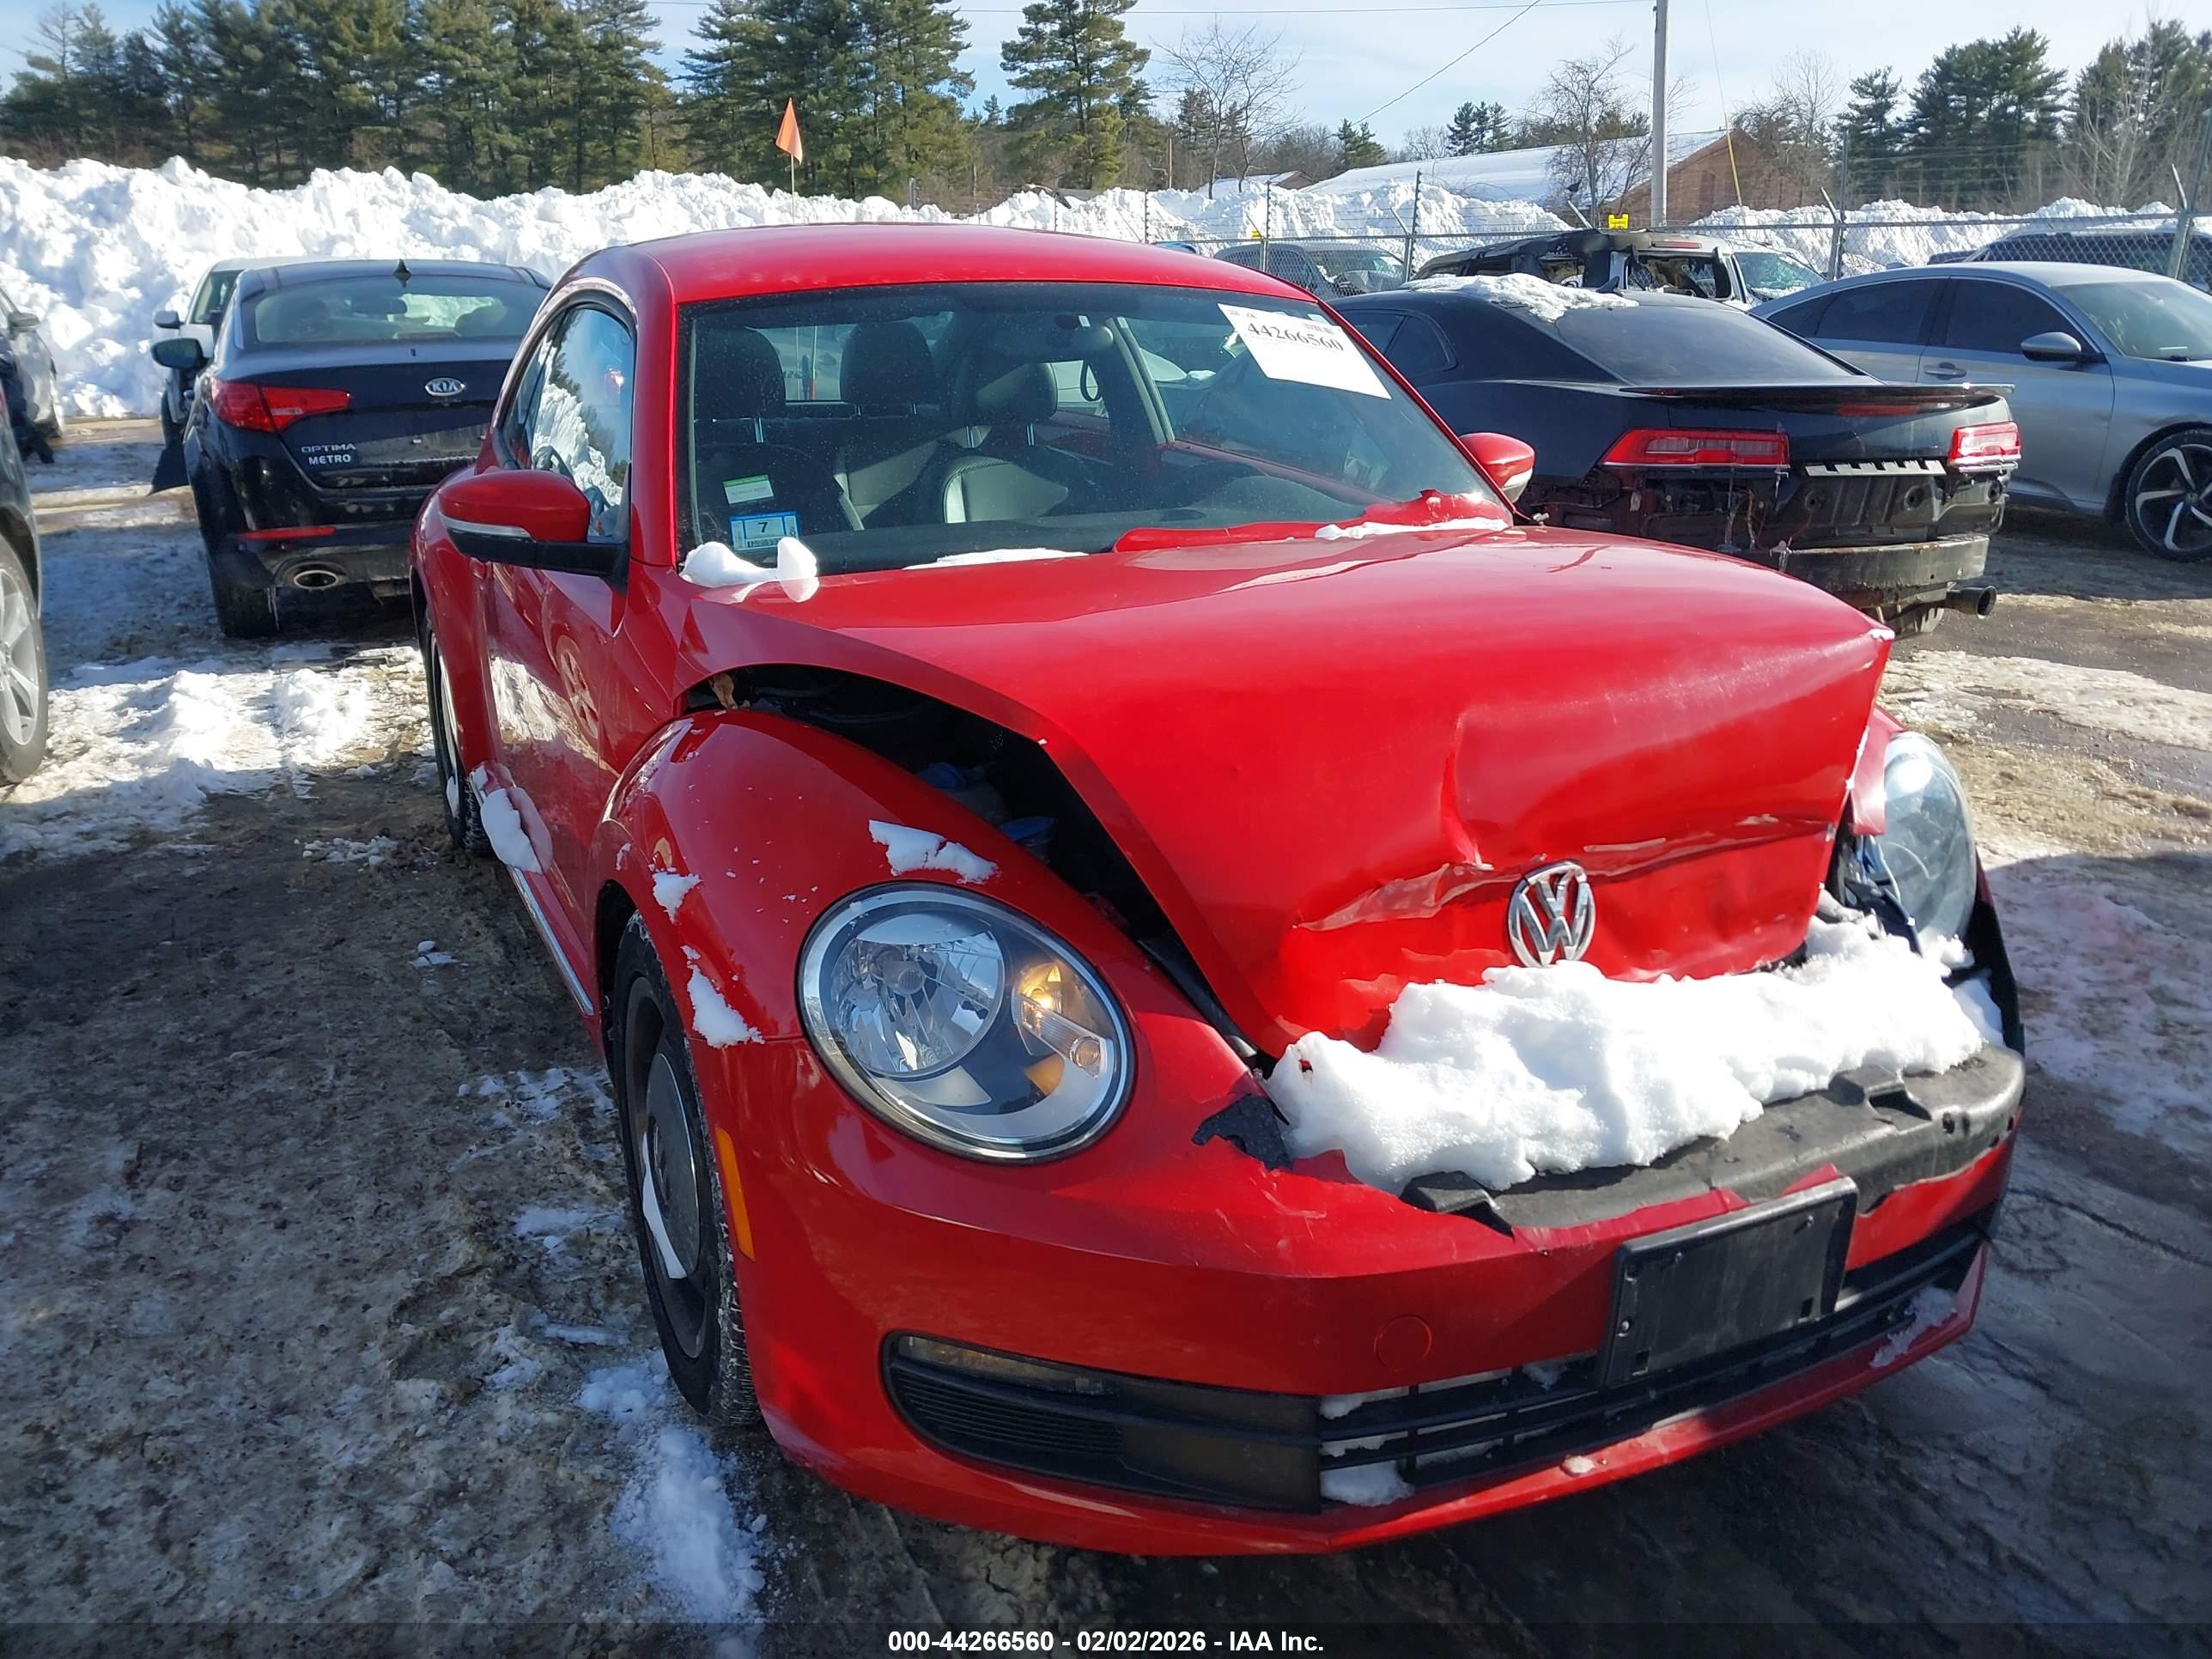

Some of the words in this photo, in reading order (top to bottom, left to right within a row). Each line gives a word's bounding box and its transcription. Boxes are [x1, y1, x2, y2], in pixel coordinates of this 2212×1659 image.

[1248, 322, 1345, 351] 44266560
[430, 380, 459, 393] KIA
[301, 442, 356, 453] OPTIMA
[308, 453, 351, 465] METRO
[757, 520, 769, 533] 7
